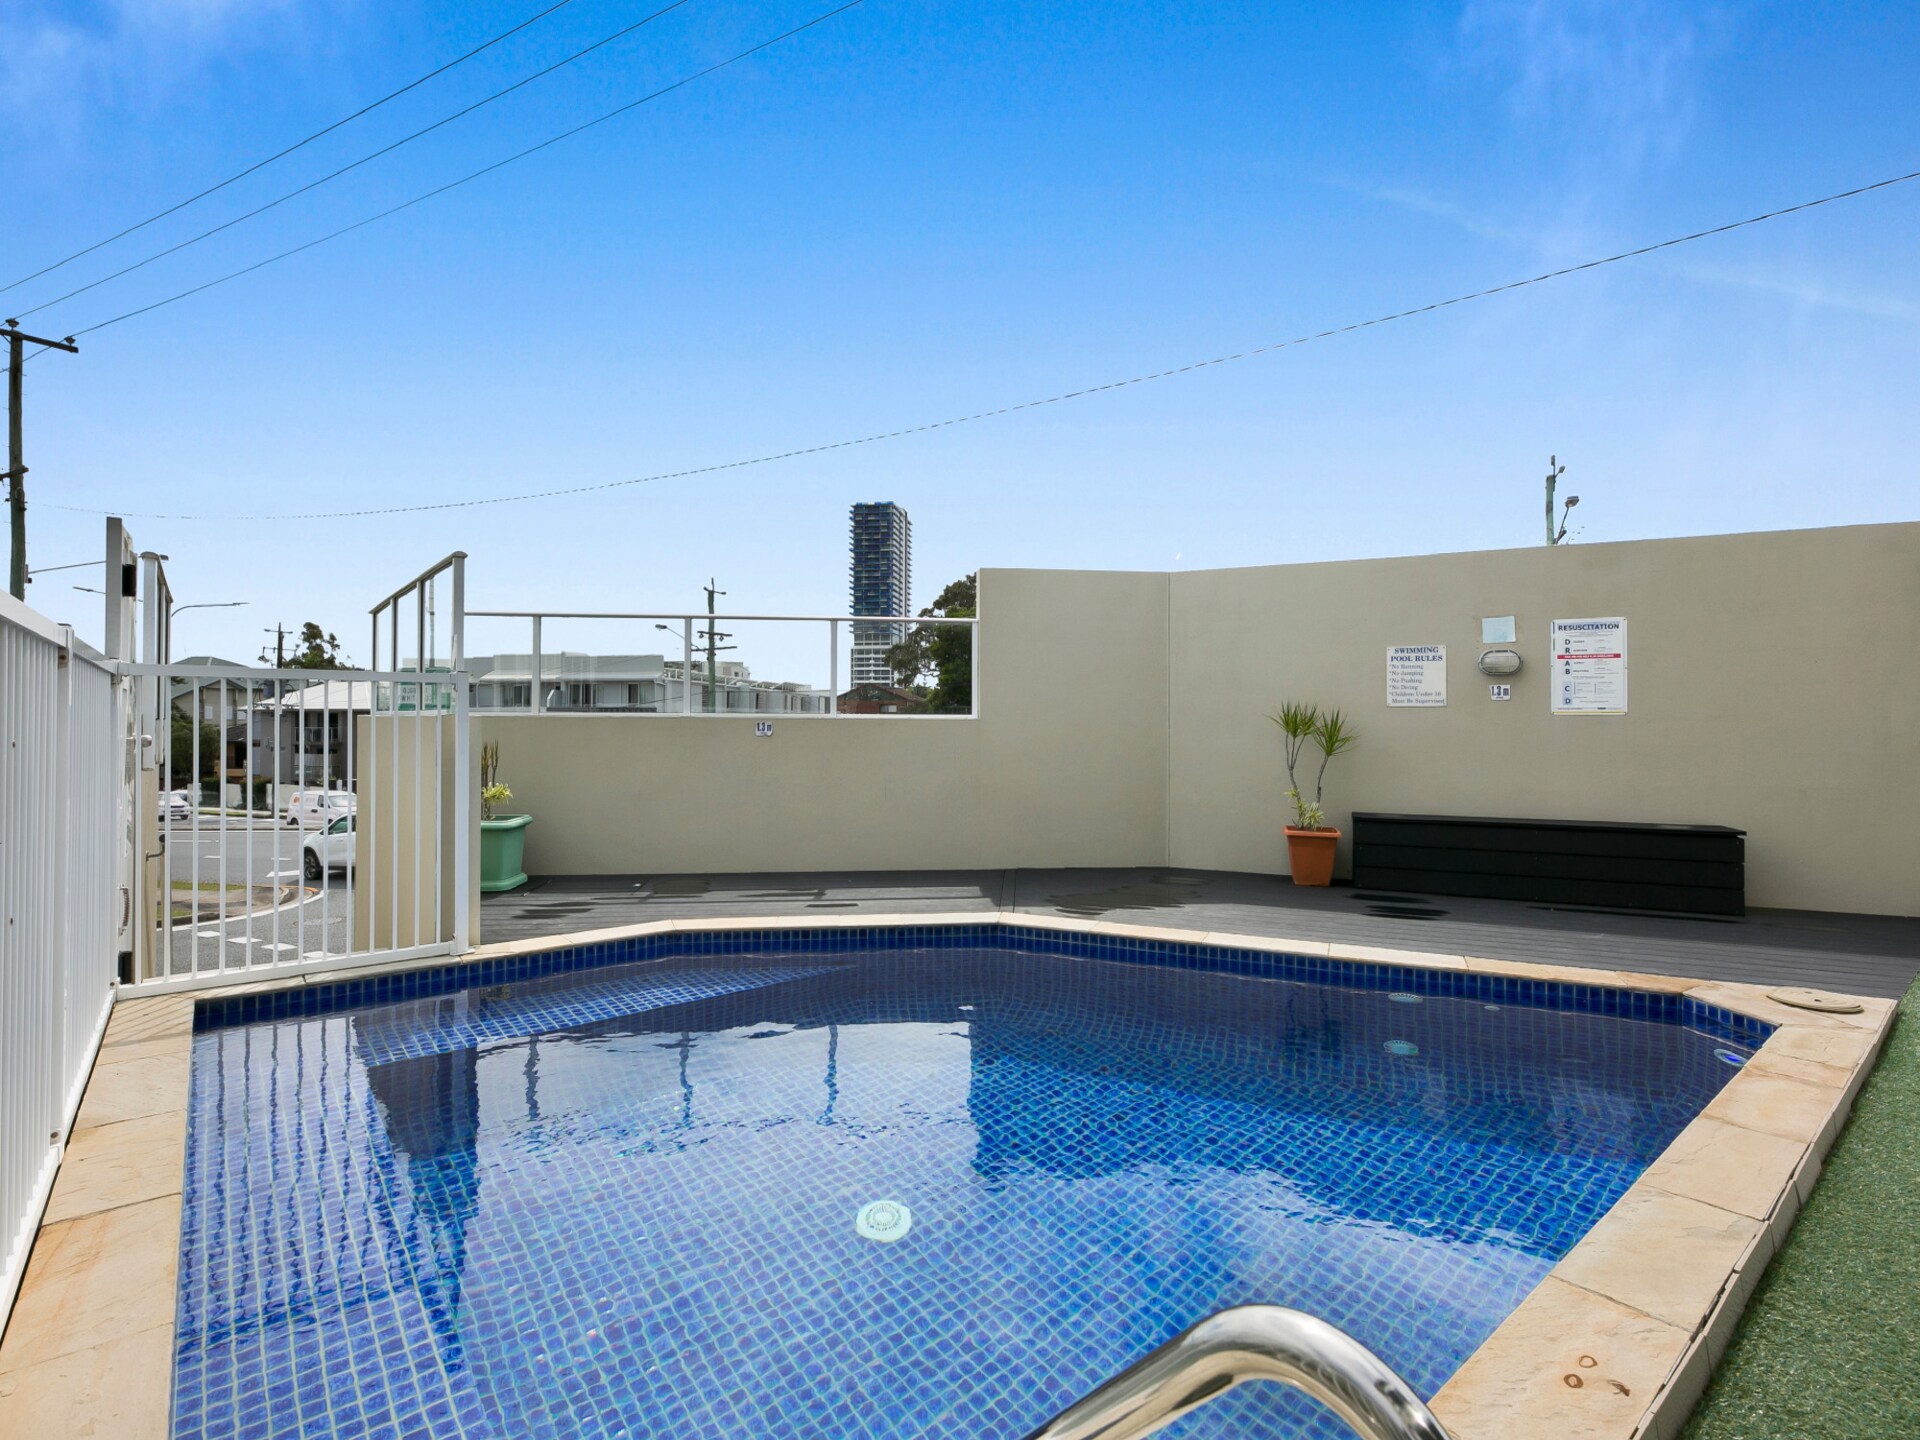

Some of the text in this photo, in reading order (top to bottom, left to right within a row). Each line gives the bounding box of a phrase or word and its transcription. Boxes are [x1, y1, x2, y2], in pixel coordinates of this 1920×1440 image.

[1558, 623, 1619, 631] RESUSCITATION
[1394, 646, 1438, 654] SWIMMING
[1491, 685, 1509, 696] 1.3 m
[757, 722, 765, 731] 1.3
